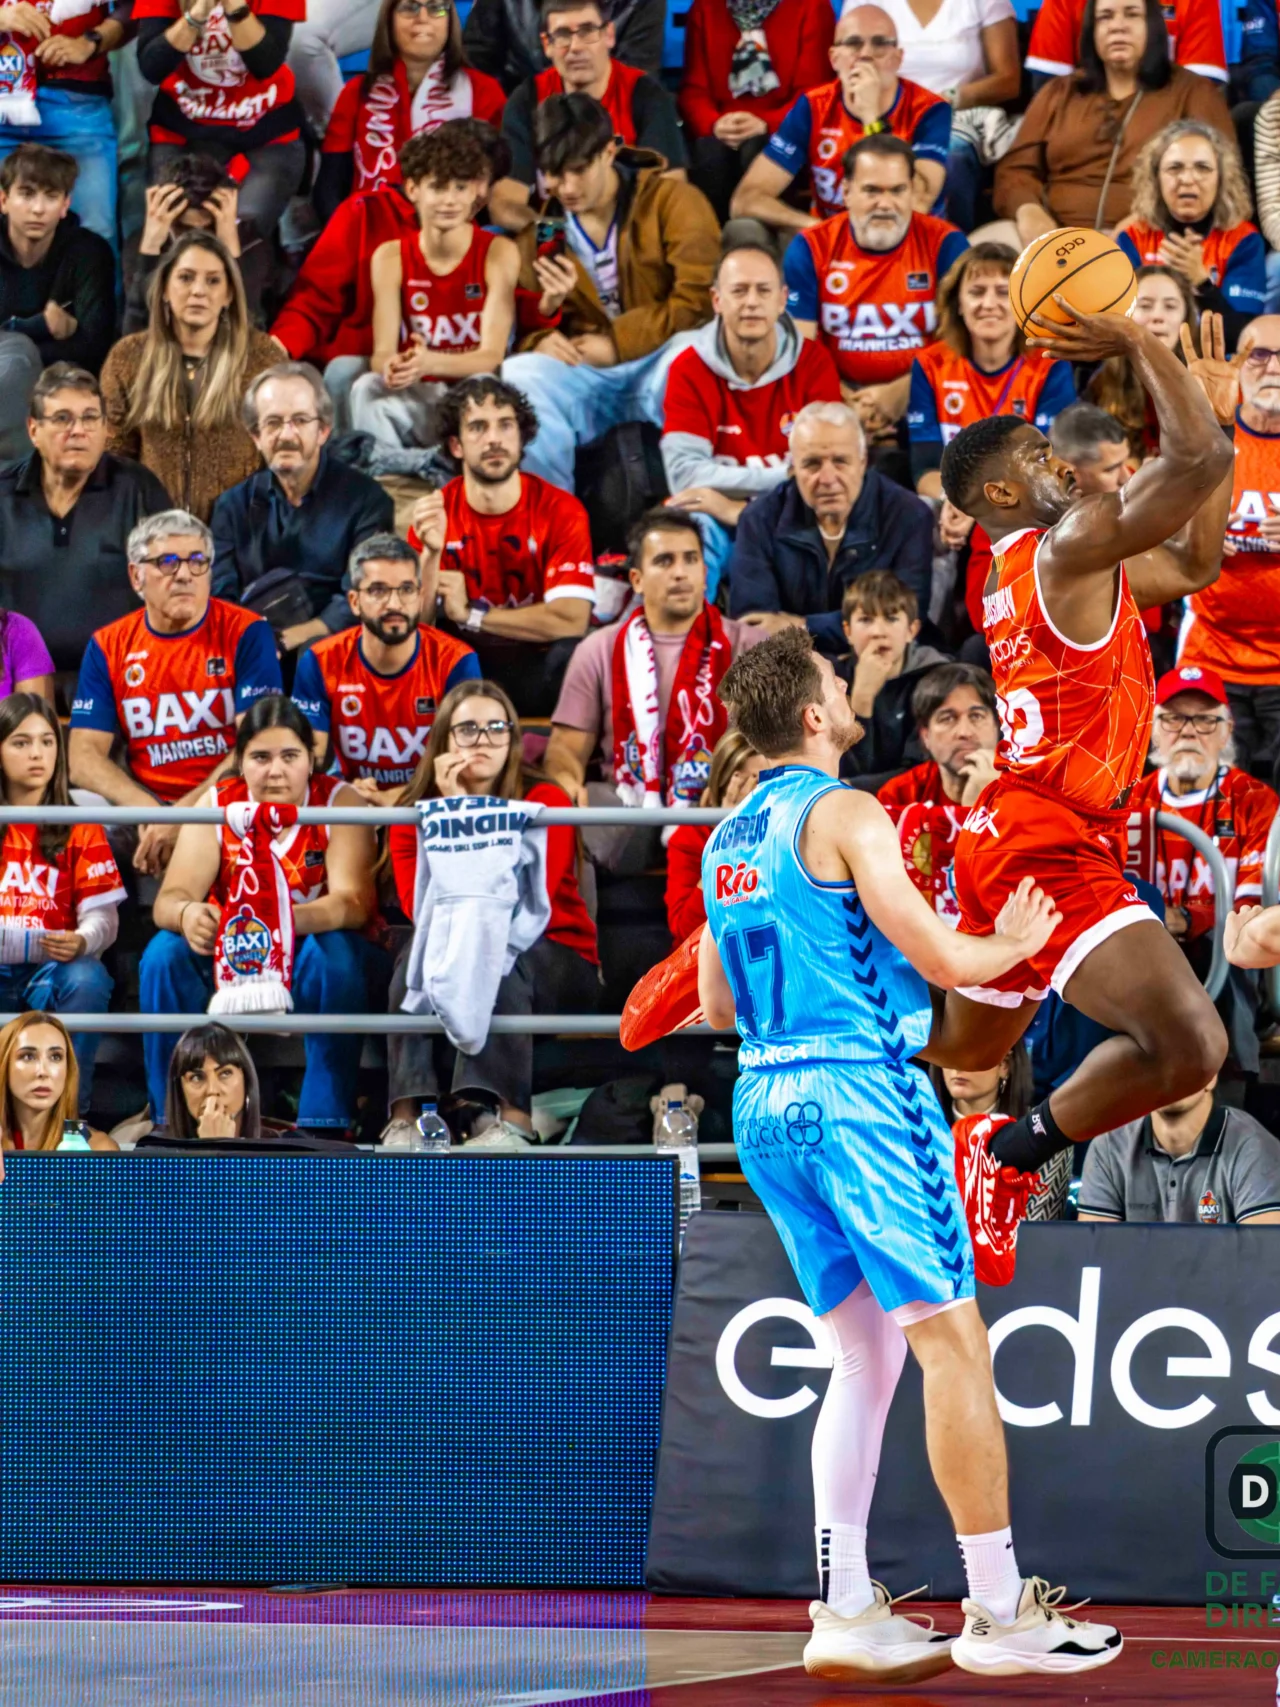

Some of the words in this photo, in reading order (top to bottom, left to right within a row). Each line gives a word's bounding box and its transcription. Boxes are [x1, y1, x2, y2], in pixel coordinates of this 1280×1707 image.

[1055, 237, 1086, 257] acb
[821, 301, 937, 339] BAXI
[121, 688, 235, 738] BAXI
[147, 733, 228, 767] MANRESA
[339, 725, 432, 764] BAX
[0, 861, 59, 898] AXI
[224, 932, 268, 953] BAXI
